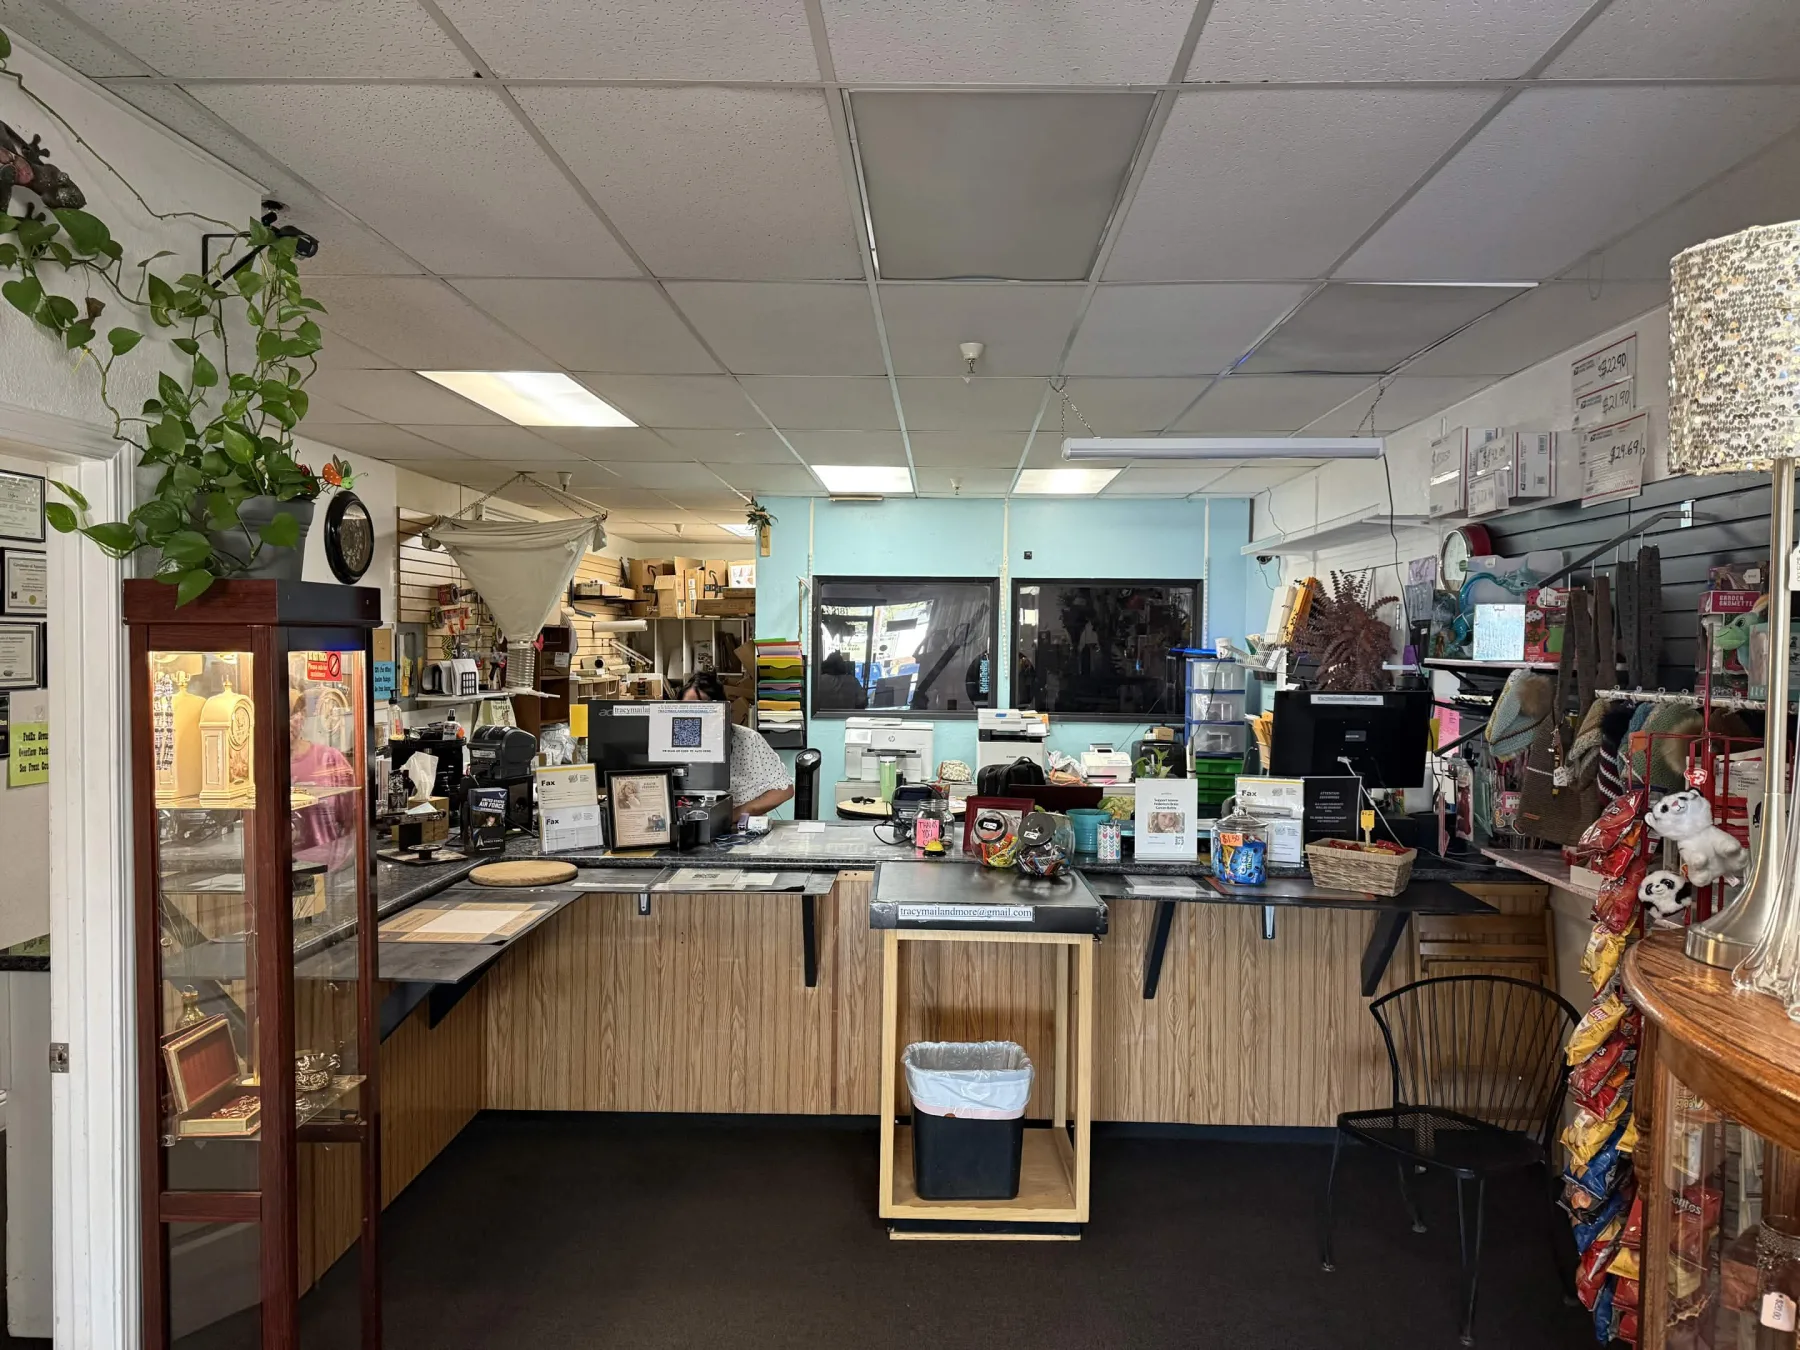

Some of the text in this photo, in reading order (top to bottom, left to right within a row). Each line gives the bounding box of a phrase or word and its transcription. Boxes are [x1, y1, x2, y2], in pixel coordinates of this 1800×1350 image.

[1241, 789, 1257, 797] Fax
[489, 802, 506, 810] FORCE
[918, 820, 938, 829] THANK
[900, 906, 1032, 919] tracymailandmore@gmail.com
